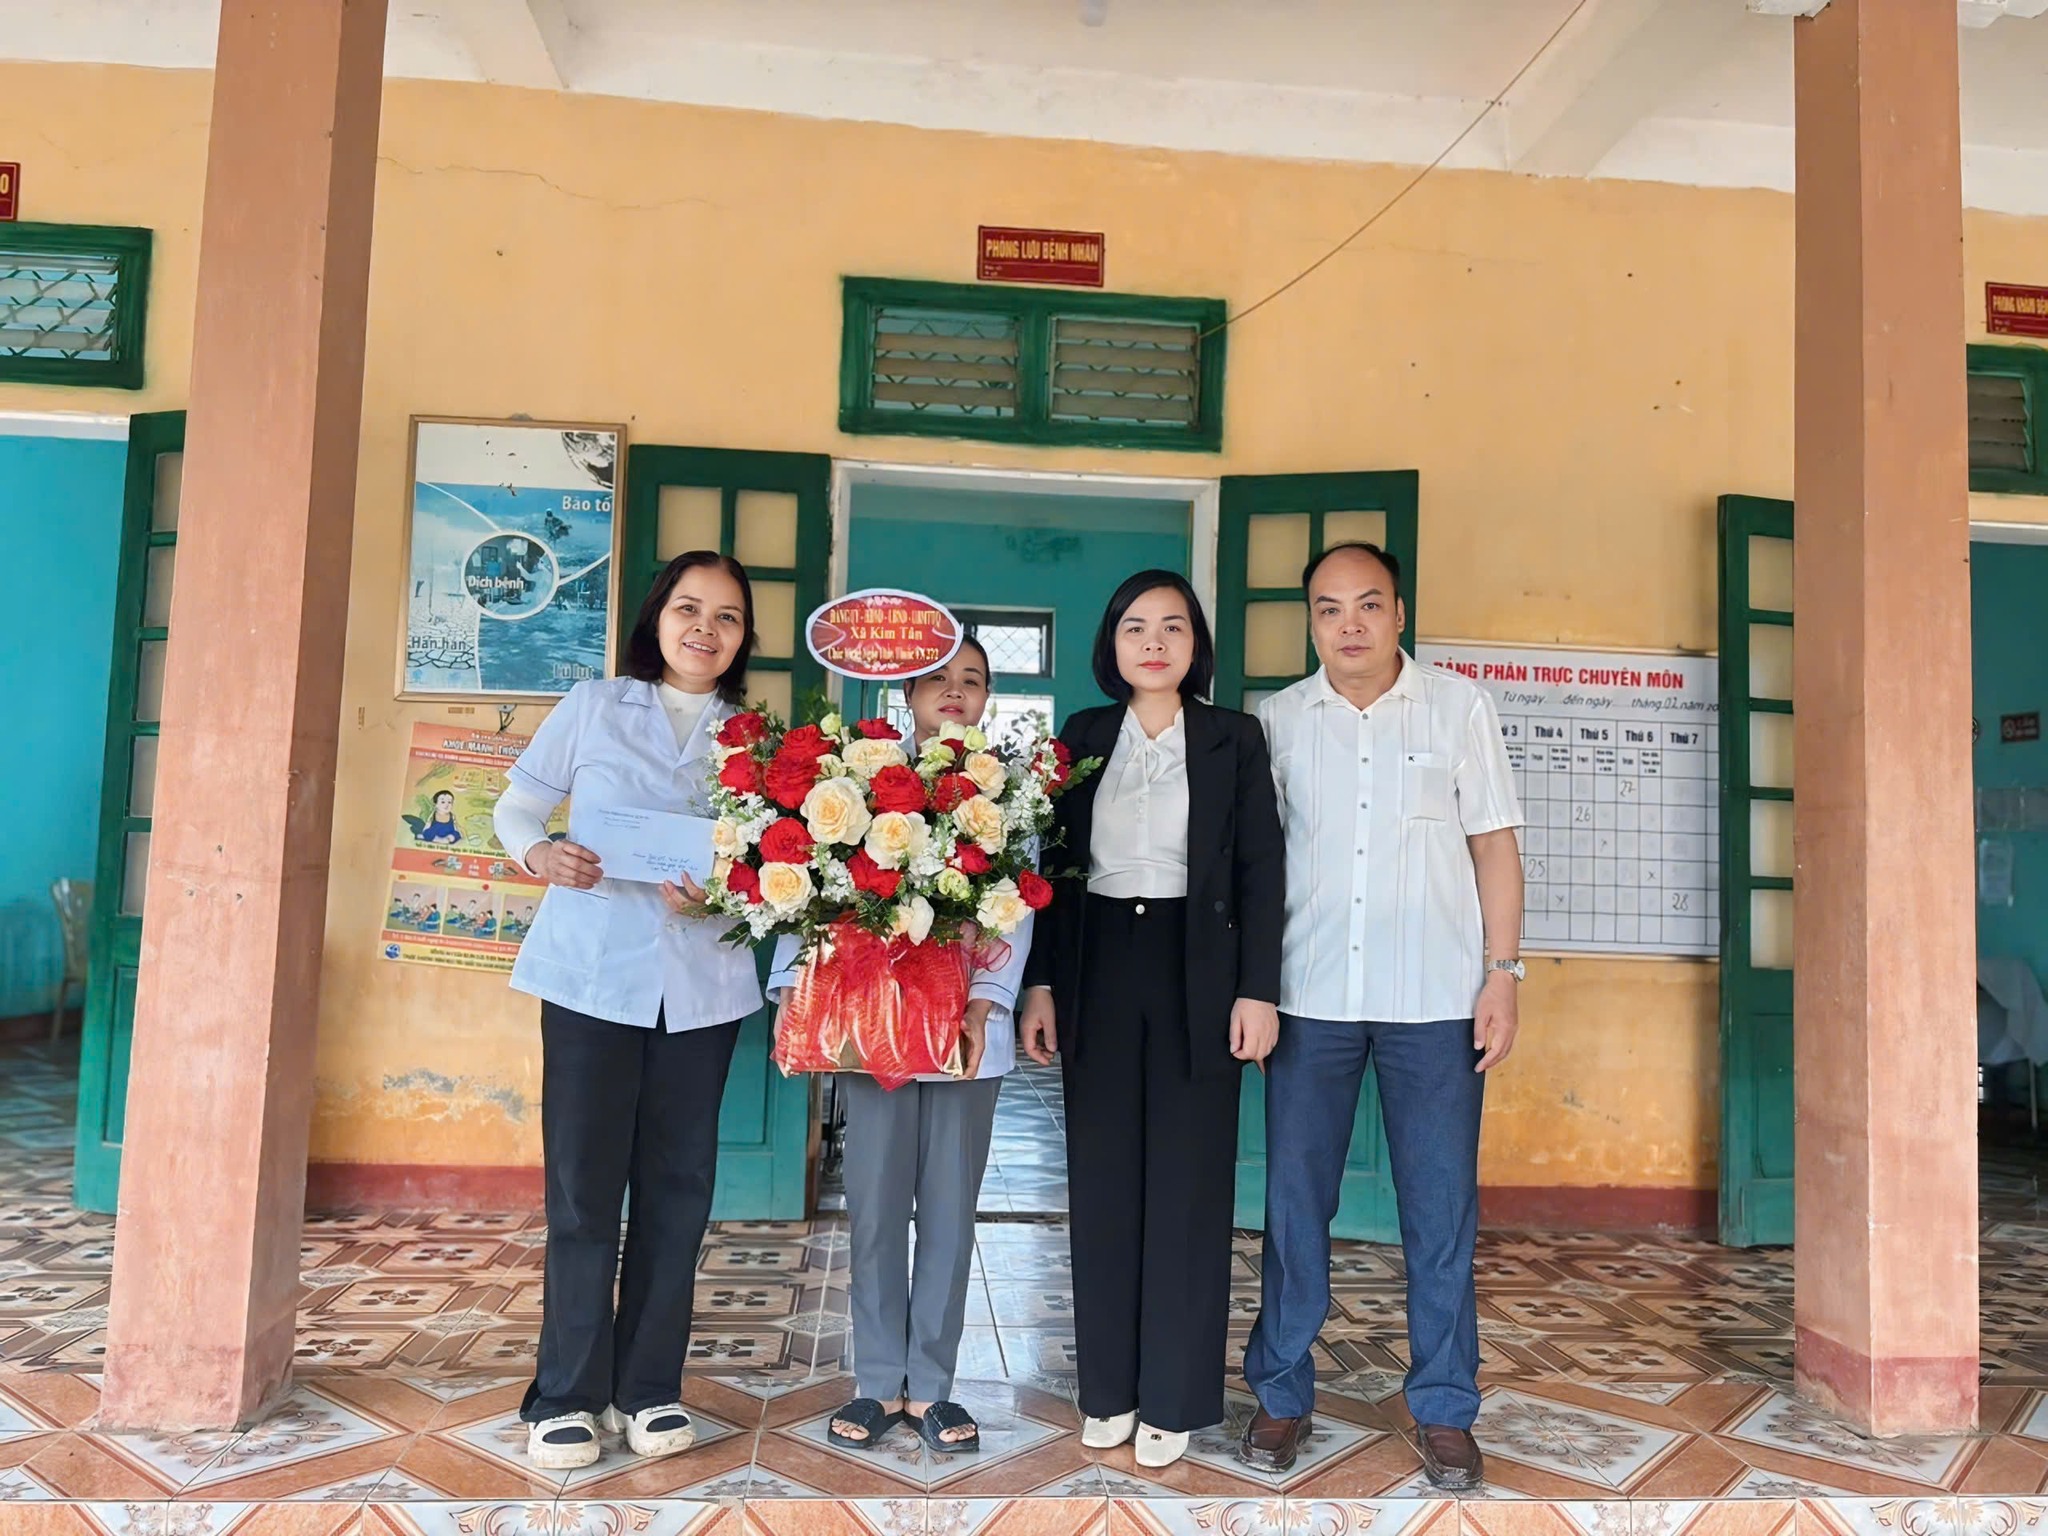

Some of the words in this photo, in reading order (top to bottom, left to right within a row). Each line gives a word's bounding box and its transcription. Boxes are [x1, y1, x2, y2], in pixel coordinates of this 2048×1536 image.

[986, 235, 1019, 258] PHÒNG
[1042, 238, 1068, 262] BỆNH
[851, 626, 866, 640] Xã
[870, 626, 895, 640] Kim
[900, 626, 922, 641] Tân
[1483, 661, 1527, 682] PHÂN
[1532, 665, 1573, 687] TRỰC
[1578, 667, 1641, 687] CHUYÊN
[1647, 669, 1684, 689] MÔN
[1535, 725, 1553, 738] Thứ
[1556, 727, 1563, 739] 4
[1580, 727, 1599, 740] Thứ
[1602, 729, 1609, 740] 5
[1625, 729, 1643, 742] Thứ
[1647, 731, 1654, 743] 6
[1670, 731, 1689, 744] Thứ
[1692, 733, 1698, 744] 7
[1575, 806, 1591, 822] 26
[1528, 858, 1546, 879] 25
